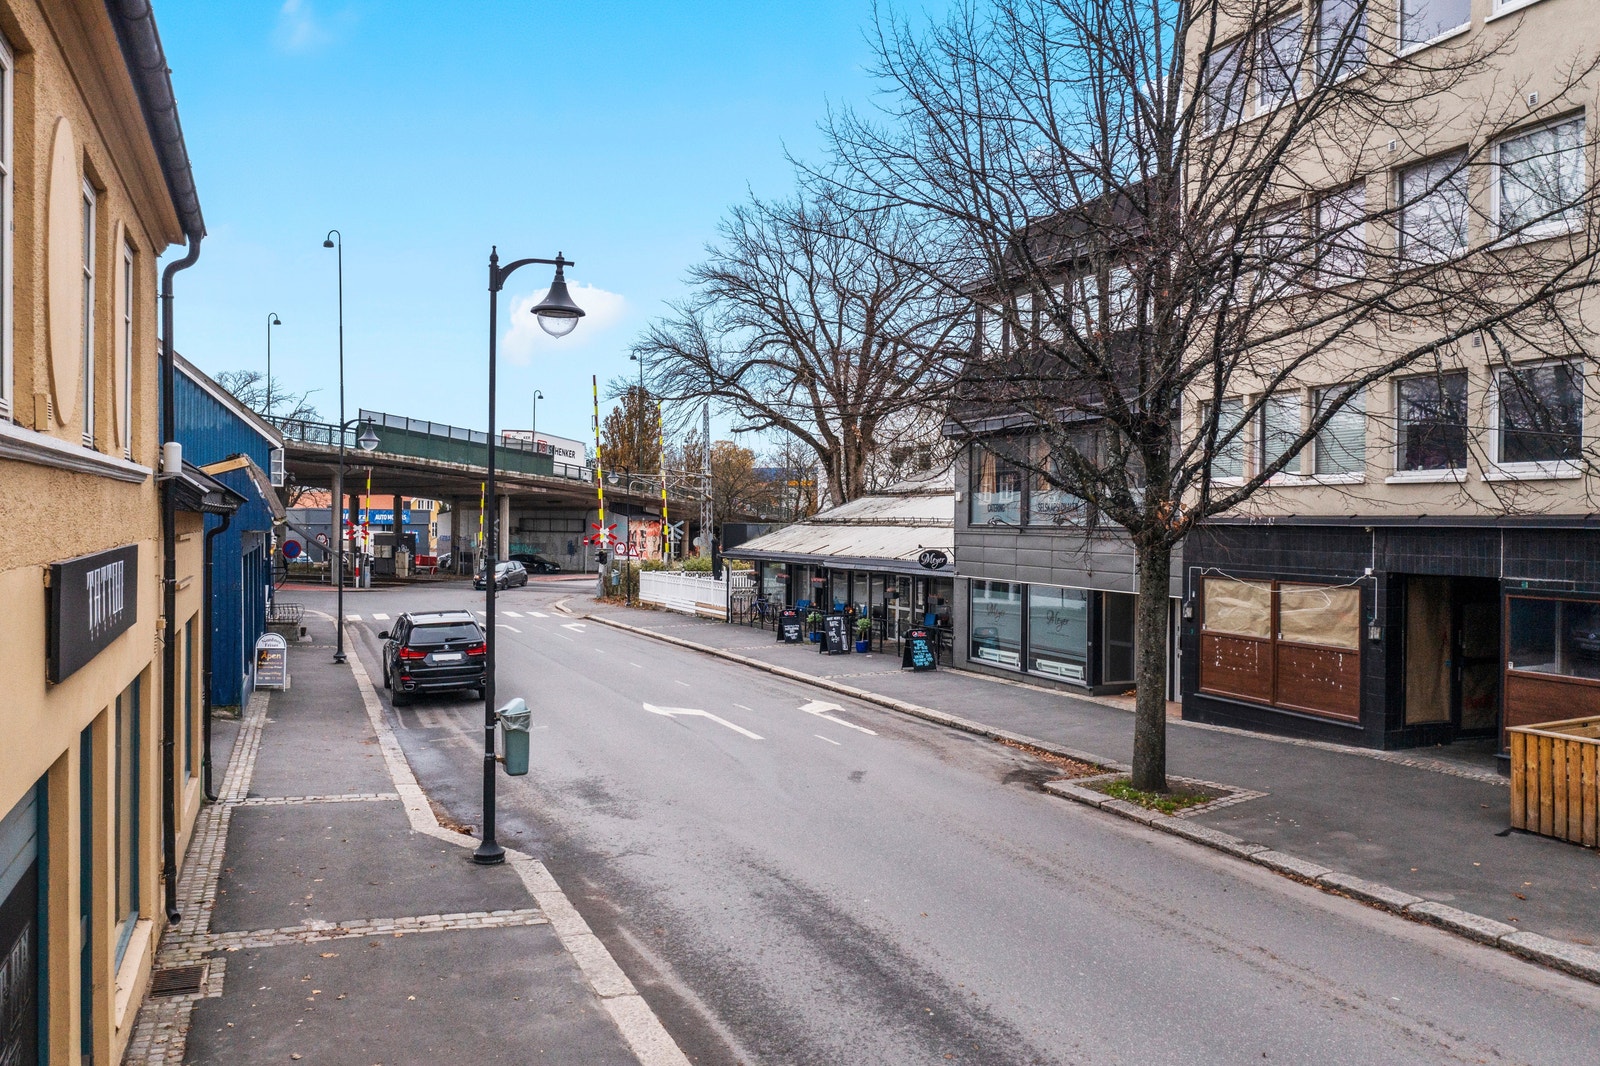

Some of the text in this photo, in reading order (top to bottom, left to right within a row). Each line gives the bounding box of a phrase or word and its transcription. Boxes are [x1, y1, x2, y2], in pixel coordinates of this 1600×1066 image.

[920, 553, 946, 569] Meyer
[86, 560, 124, 634] TATTOO
[260, 650, 282, 661] Åpen
